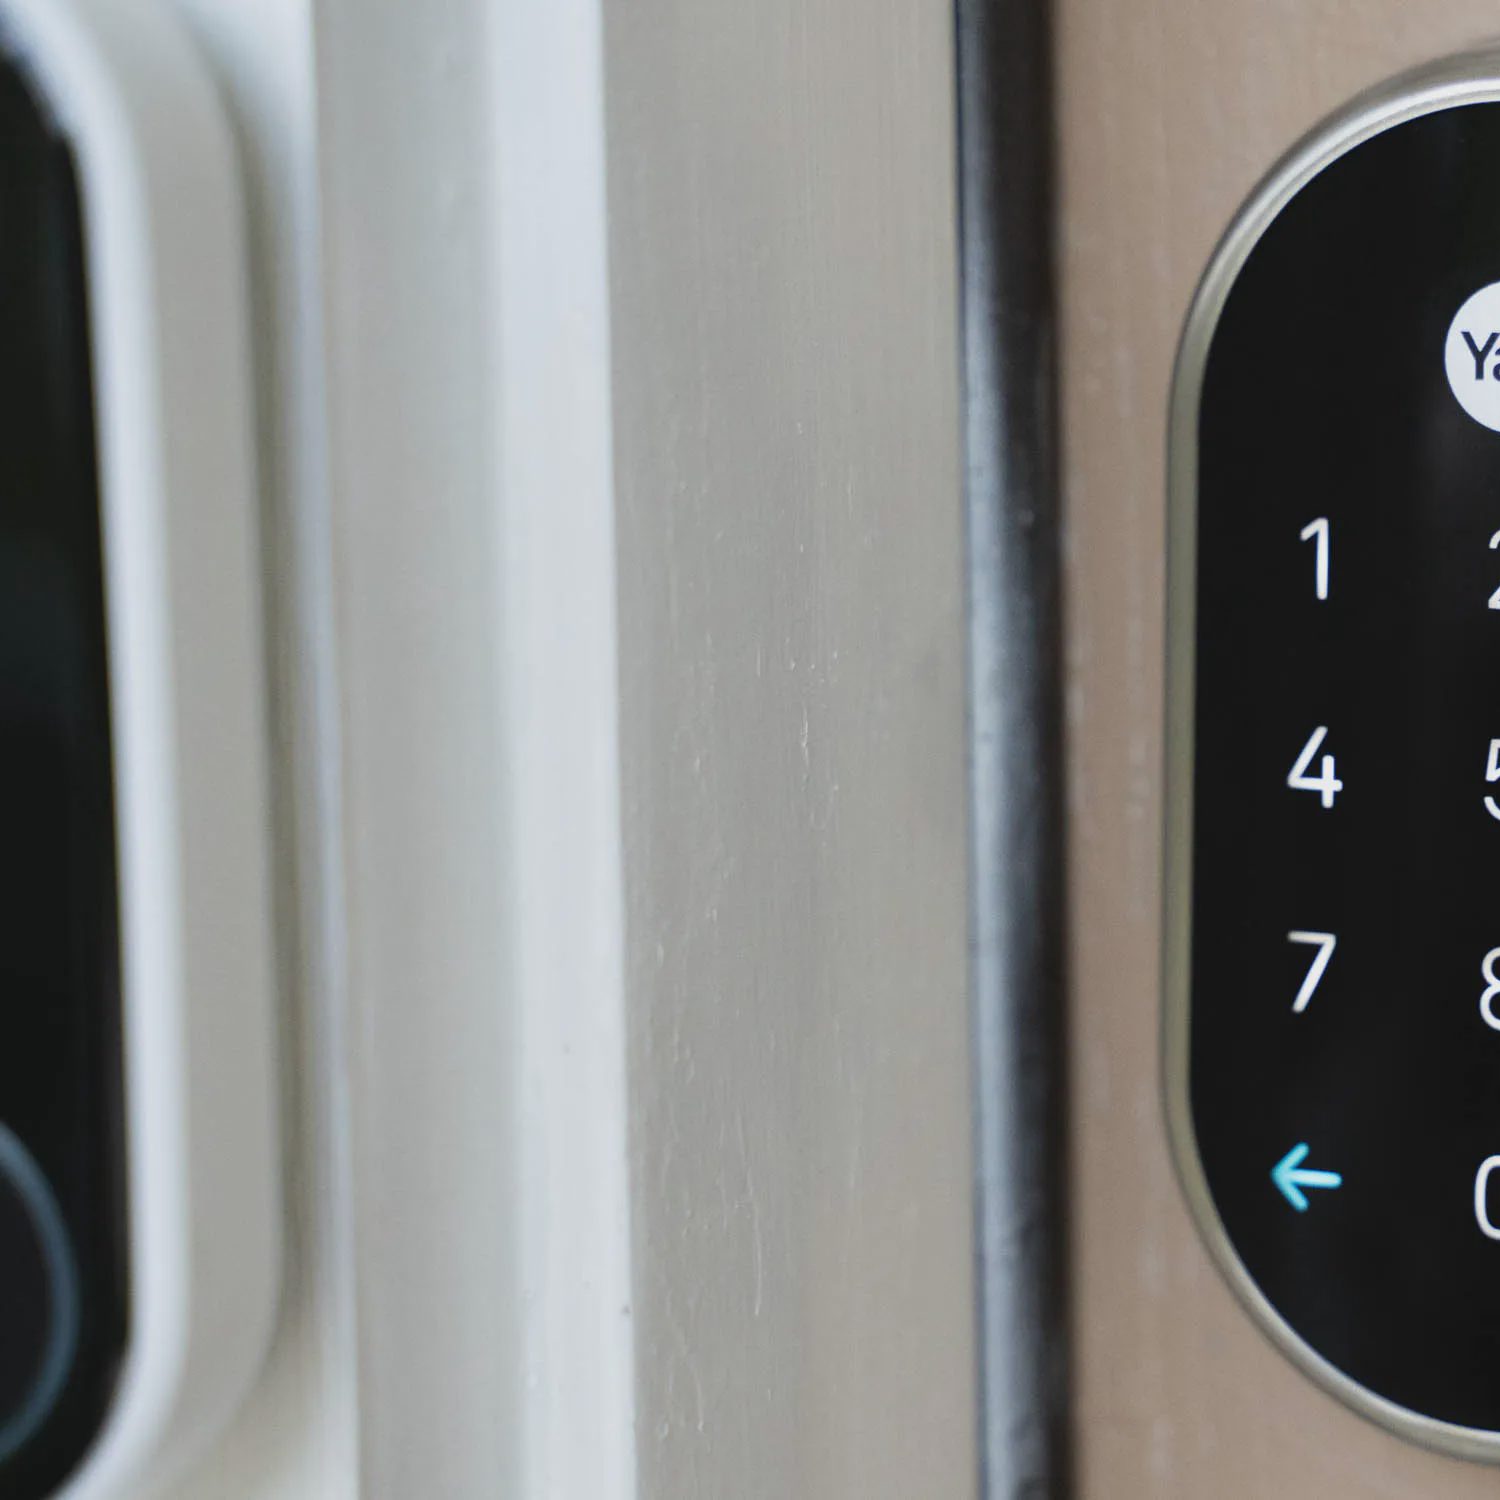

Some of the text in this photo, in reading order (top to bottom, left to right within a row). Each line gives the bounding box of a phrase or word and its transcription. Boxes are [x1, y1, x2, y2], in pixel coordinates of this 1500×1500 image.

[1299, 517, 1329, 601] 1
[1286, 725, 1344, 809] 4
[1287, 930, 1337, 1013] 7
